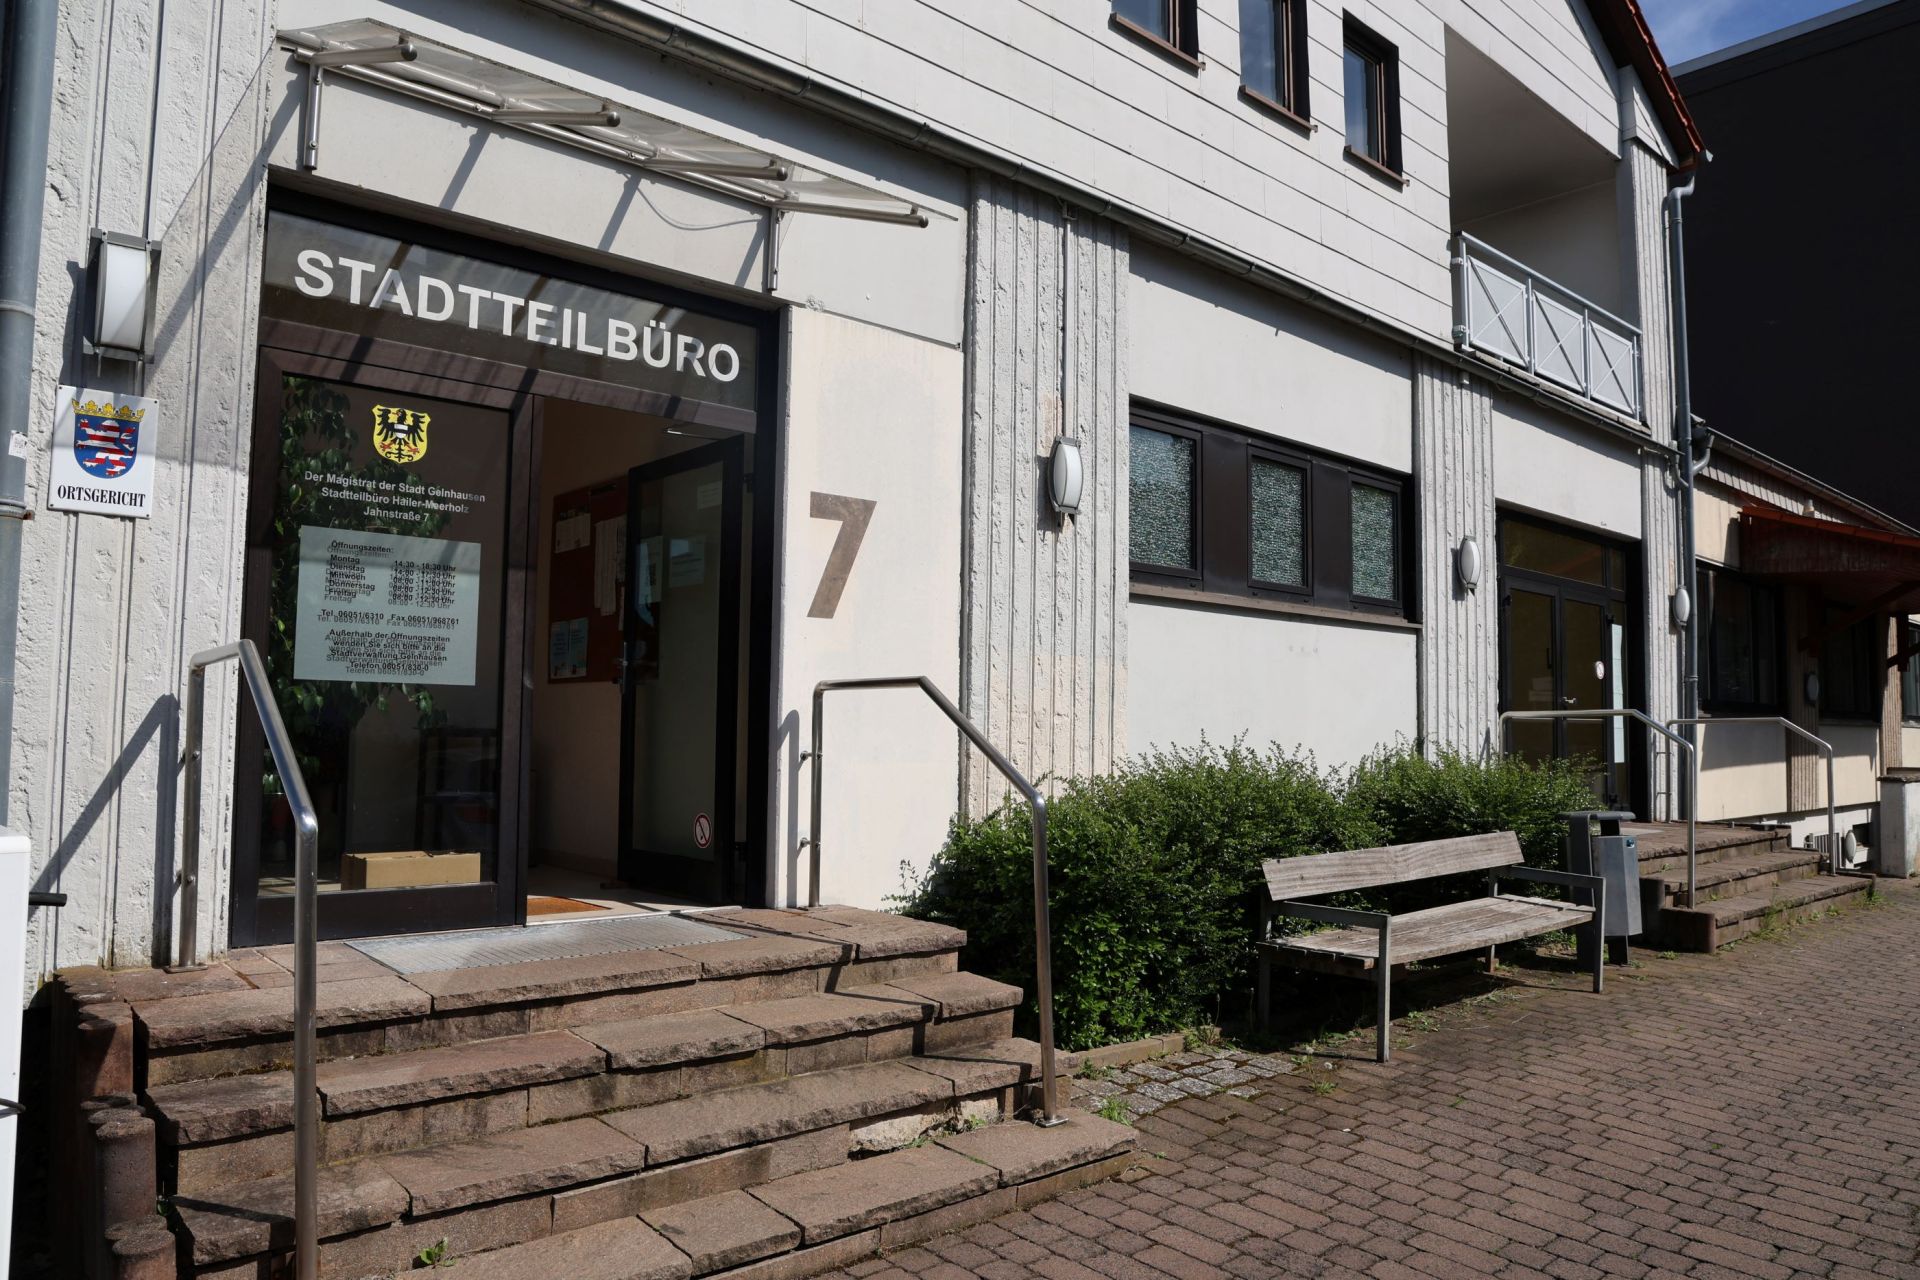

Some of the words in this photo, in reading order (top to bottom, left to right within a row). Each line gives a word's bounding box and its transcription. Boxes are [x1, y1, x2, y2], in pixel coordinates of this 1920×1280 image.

[294, 248, 741, 383] STADTTEILBÜRO
[304, 470, 324, 482] Der
[326, 473, 377, 489] Magistrat
[379, 480, 396, 491] der
[398, 482, 425, 495] Stadt
[427, 487, 486, 503] Gelnhausen
[57, 484, 146, 508] ORTSGERICHT
[321, 487, 390, 504] Stadtteilbüro
[393, 496, 471, 514] Hailer-Meerholz
[363, 506, 421, 522] Jahnstraße
[424, 513, 429, 522] 7
[330, 554, 360, 564] Montag
[442, 564, 457, 572] Uhr
[807, 491, 878, 619] 7
[329, 563, 365, 573] Dienstag
[442, 572, 456, 580] Uhr
[329, 571, 366, 580] Mittwoch
[442, 580, 456, 588] Uhr
[328, 588, 357, 599] Freitag
[441, 597, 455, 605] Uhr
[329, 579, 375, 591] Donnerstag
[442, 589, 455, 597] Uhr
[337, 610, 384, 621] 06051/6310
[391, 614, 405, 622] Fax
[329, 629, 372, 638] Außerhalb
[390, 632, 450, 643] Öffnungszeiten
[333, 640, 366, 648] wenden
[369, 640, 381, 648] Sie
[330, 650, 398, 661] Stadtverwaltung
[401, 653, 448, 662] Gelnhausen
[350, 662, 380, 670] Telefon
[382, 663, 429, 672] 06051/830-0
